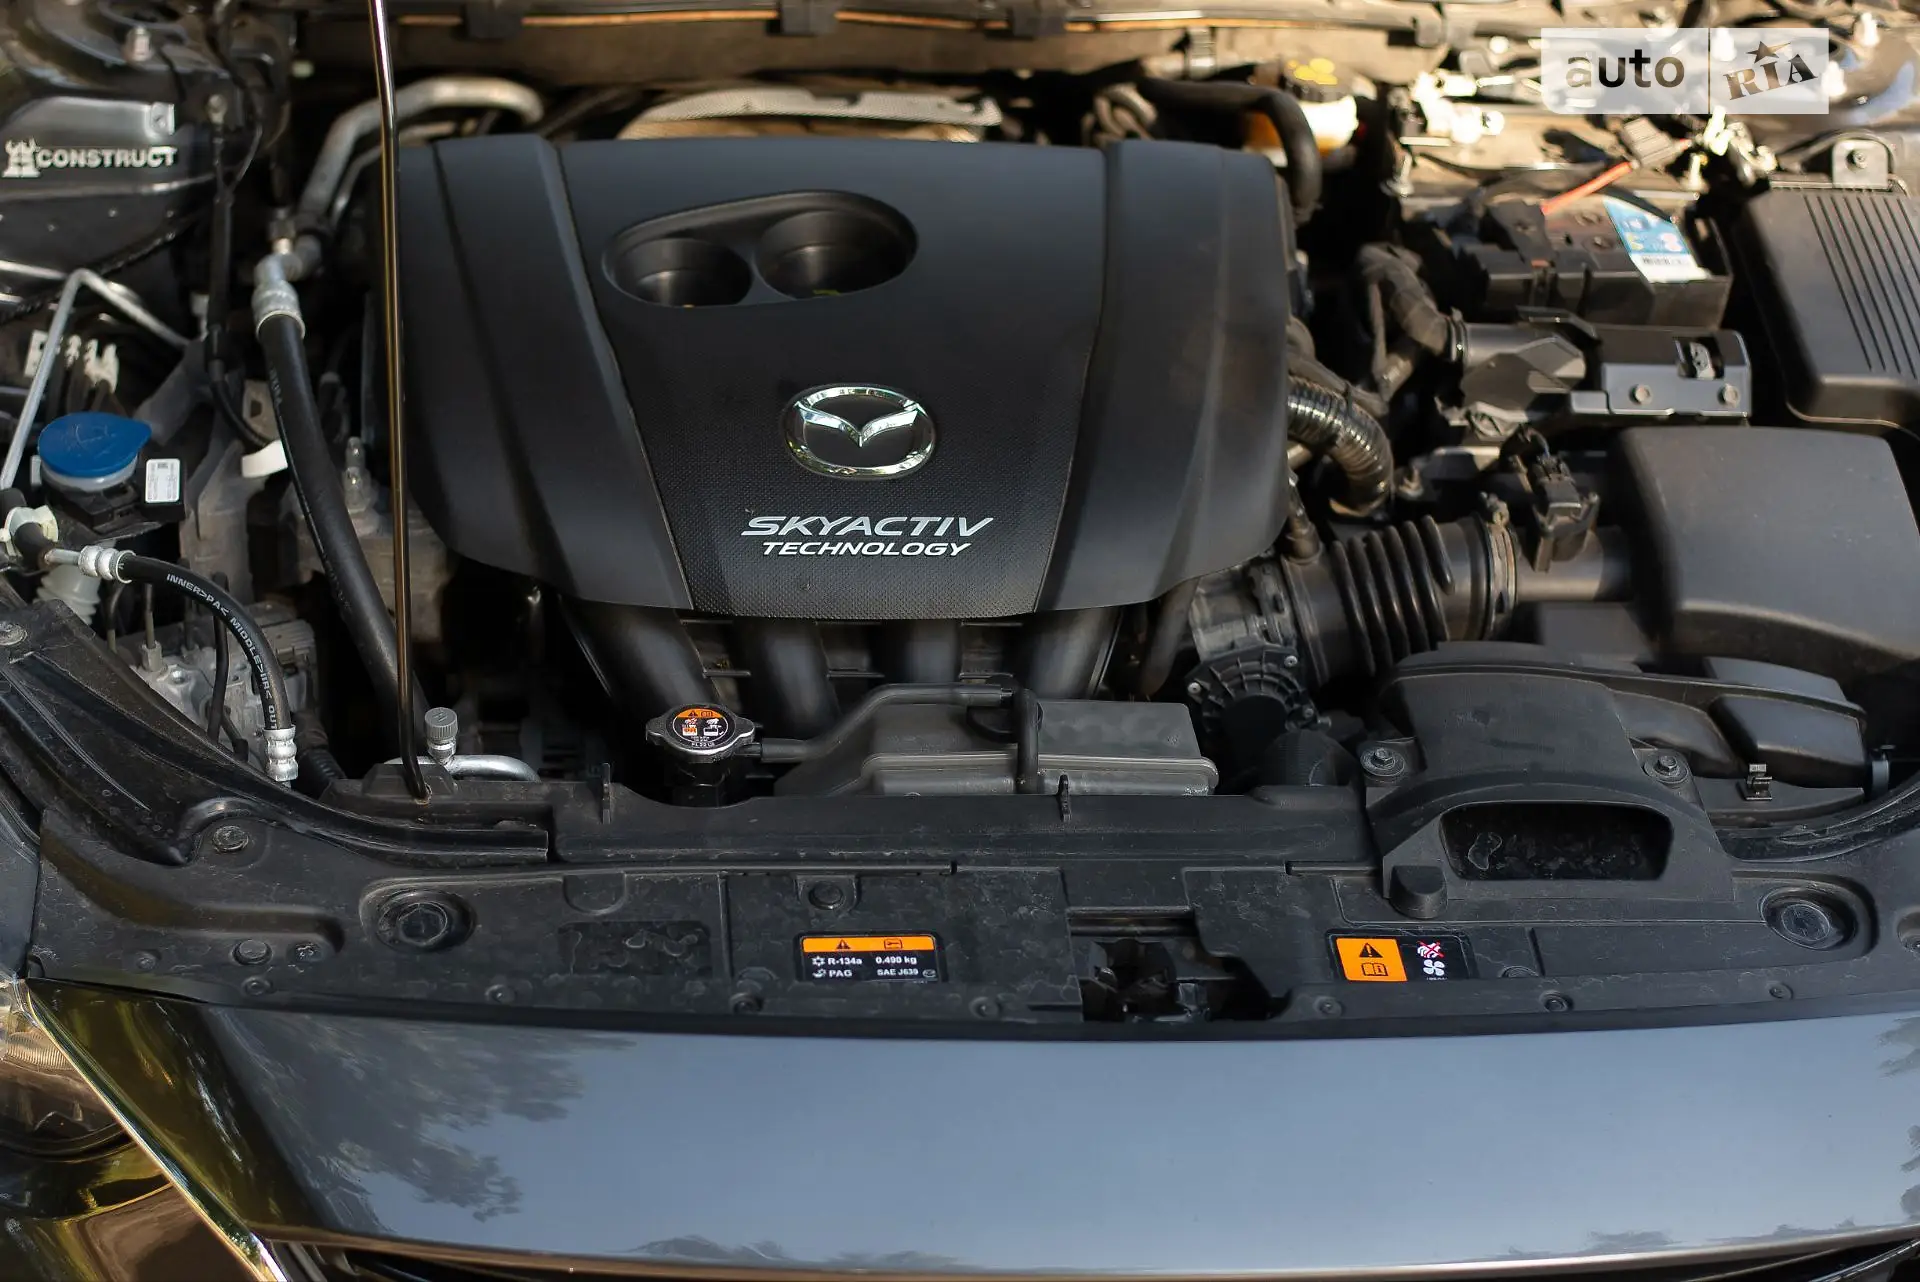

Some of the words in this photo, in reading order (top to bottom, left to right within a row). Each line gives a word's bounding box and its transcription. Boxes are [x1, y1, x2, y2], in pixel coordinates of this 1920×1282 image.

[36, 146, 178, 168] CONSTRUCT
[741, 516, 994, 537] SKYACTIV
[762, 541, 972, 556] TECHNOLOGY
[827, 957, 863, 966] R-134a
[904, 956, 917, 965] kg
[829, 969, 853, 978] PAG
[877, 968, 896, 976] SAE
